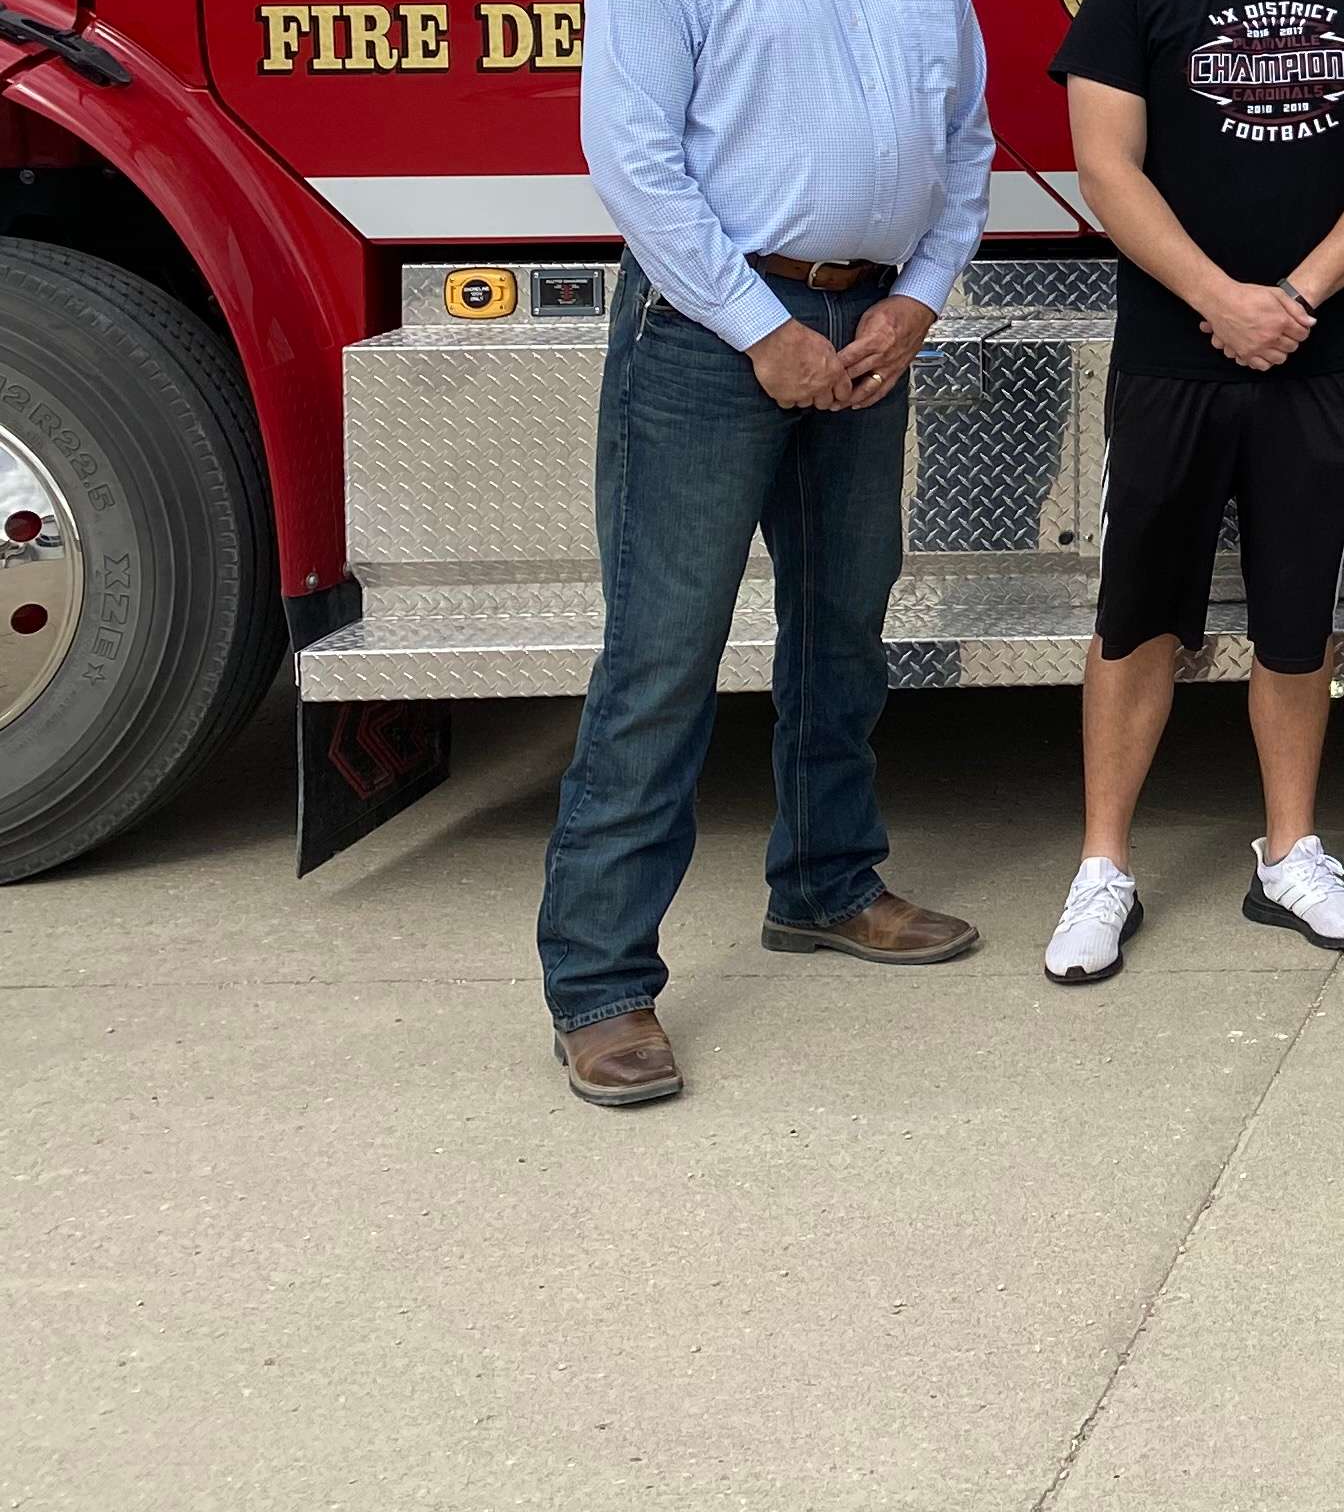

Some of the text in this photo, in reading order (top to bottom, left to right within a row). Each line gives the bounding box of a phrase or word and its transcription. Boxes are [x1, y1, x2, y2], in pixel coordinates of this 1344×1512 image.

[1208, 1, 1338, 26] 4X DISTRICT
[259, 3, 449, 70] FIRE
[1232, 35, 1321, 49] PLAINVILLE
[1246, 27, 1304, 38] 2016 2017
[1232, 85, 1324, 102] CARDINALS
[1283, 102, 1309, 113] 2019
[1221, 112, 1339, 142] FOOTBALL
[92, 552, 131, 661] XZE
